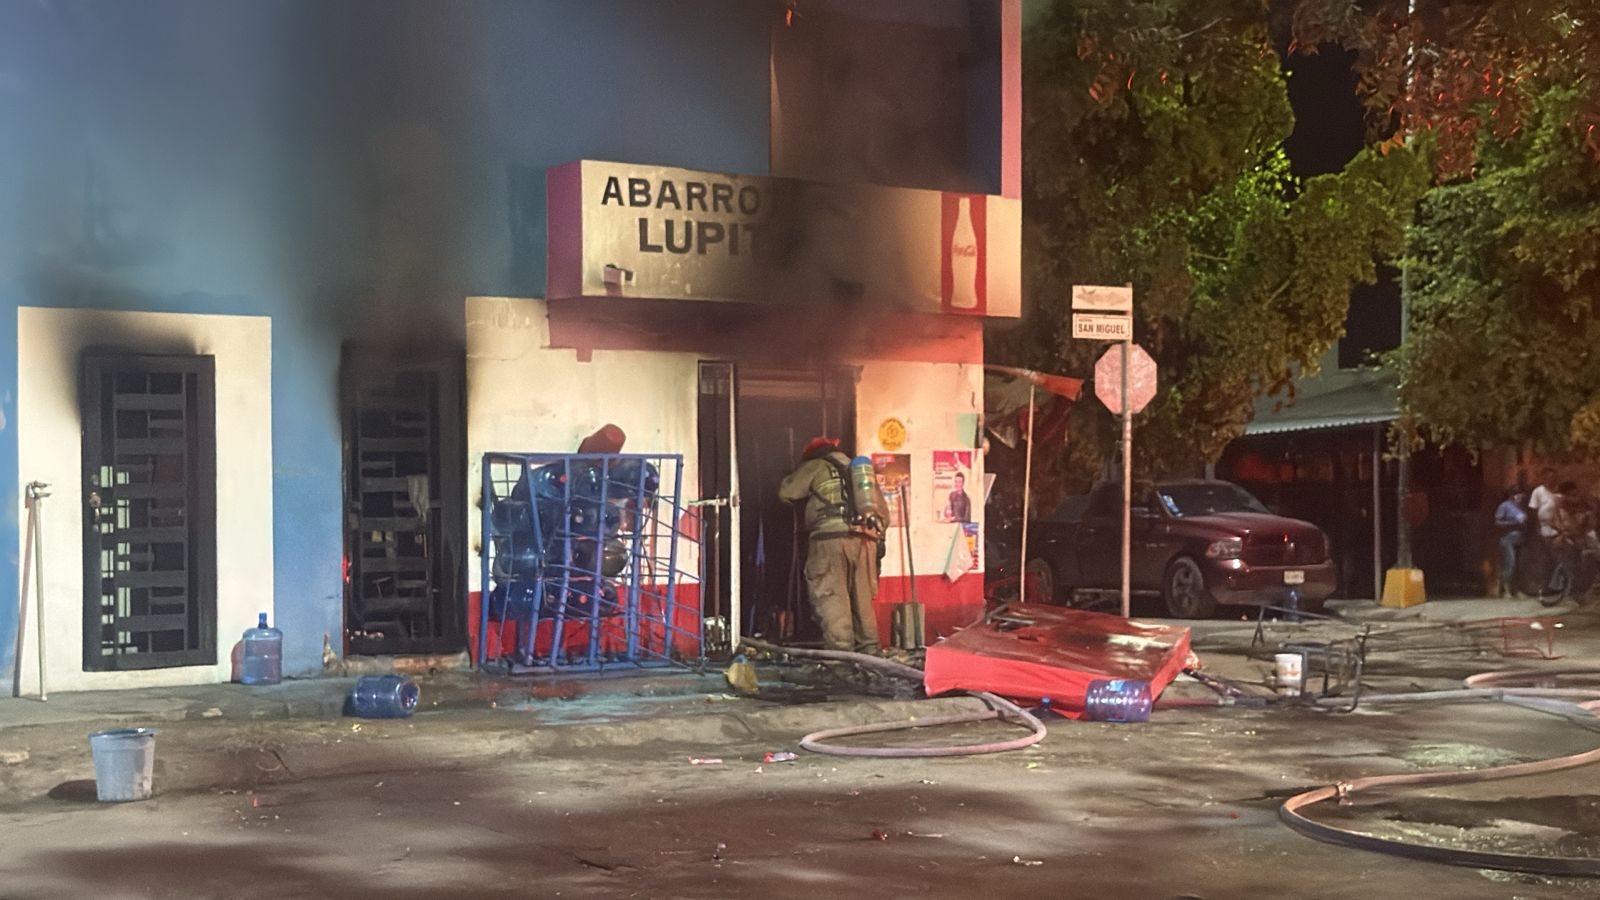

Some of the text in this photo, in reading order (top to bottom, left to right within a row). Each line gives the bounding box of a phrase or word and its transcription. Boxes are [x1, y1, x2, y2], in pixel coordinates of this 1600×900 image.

[601, 176, 761, 215] ABARRO
[1078, 323, 1125, 334] SAN MIGUEL
